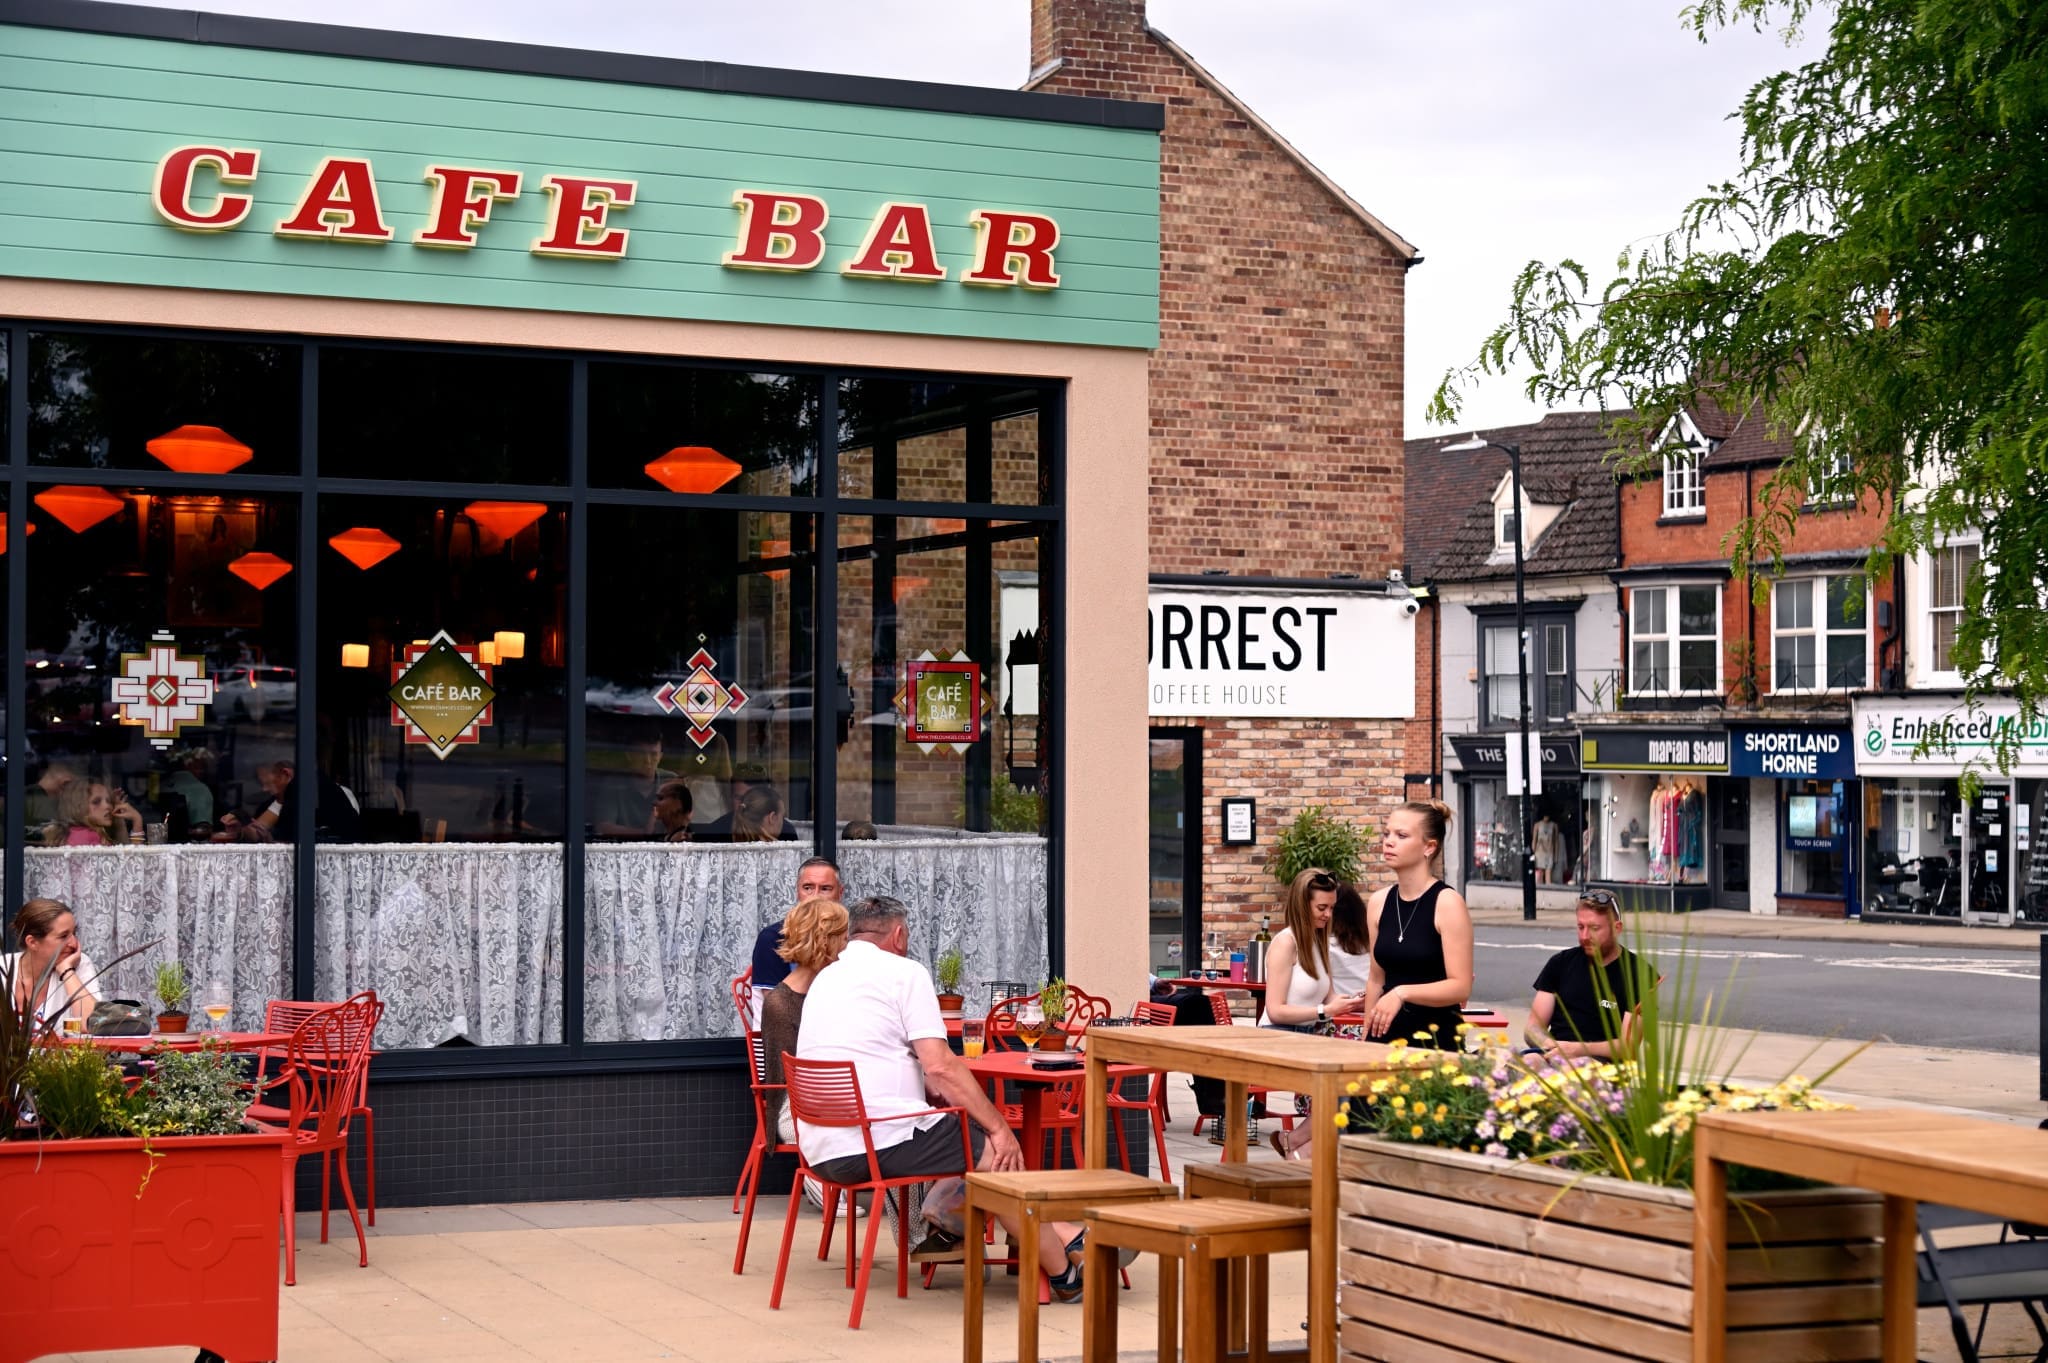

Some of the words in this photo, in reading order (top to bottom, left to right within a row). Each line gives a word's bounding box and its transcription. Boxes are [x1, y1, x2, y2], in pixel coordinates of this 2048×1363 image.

[152, 145, 638, 259] CAFE
[721, 189, 1061, 289] BAR
[1149, 604, 1337, 671] RREST
[402, 682, 445, 701] CAFÉ
[449, 686, 482, 701] BAR
[926, 682, 962, 702] CAFÉ
[1153, 684, 1211, 704] OFFEE
[1223, 685, 1288, 705] HOUSE
[930, 704, 957, 720] BAR
[1744, 733, 1840, 753] SHORTLAND
[1475, 748, 1503, 762] THE
[1762, 754, 1818, 774] HORNE
[1794, 839, 1812, 847] TOUCH
[1813, 840, 1832, 848] SCREEN
